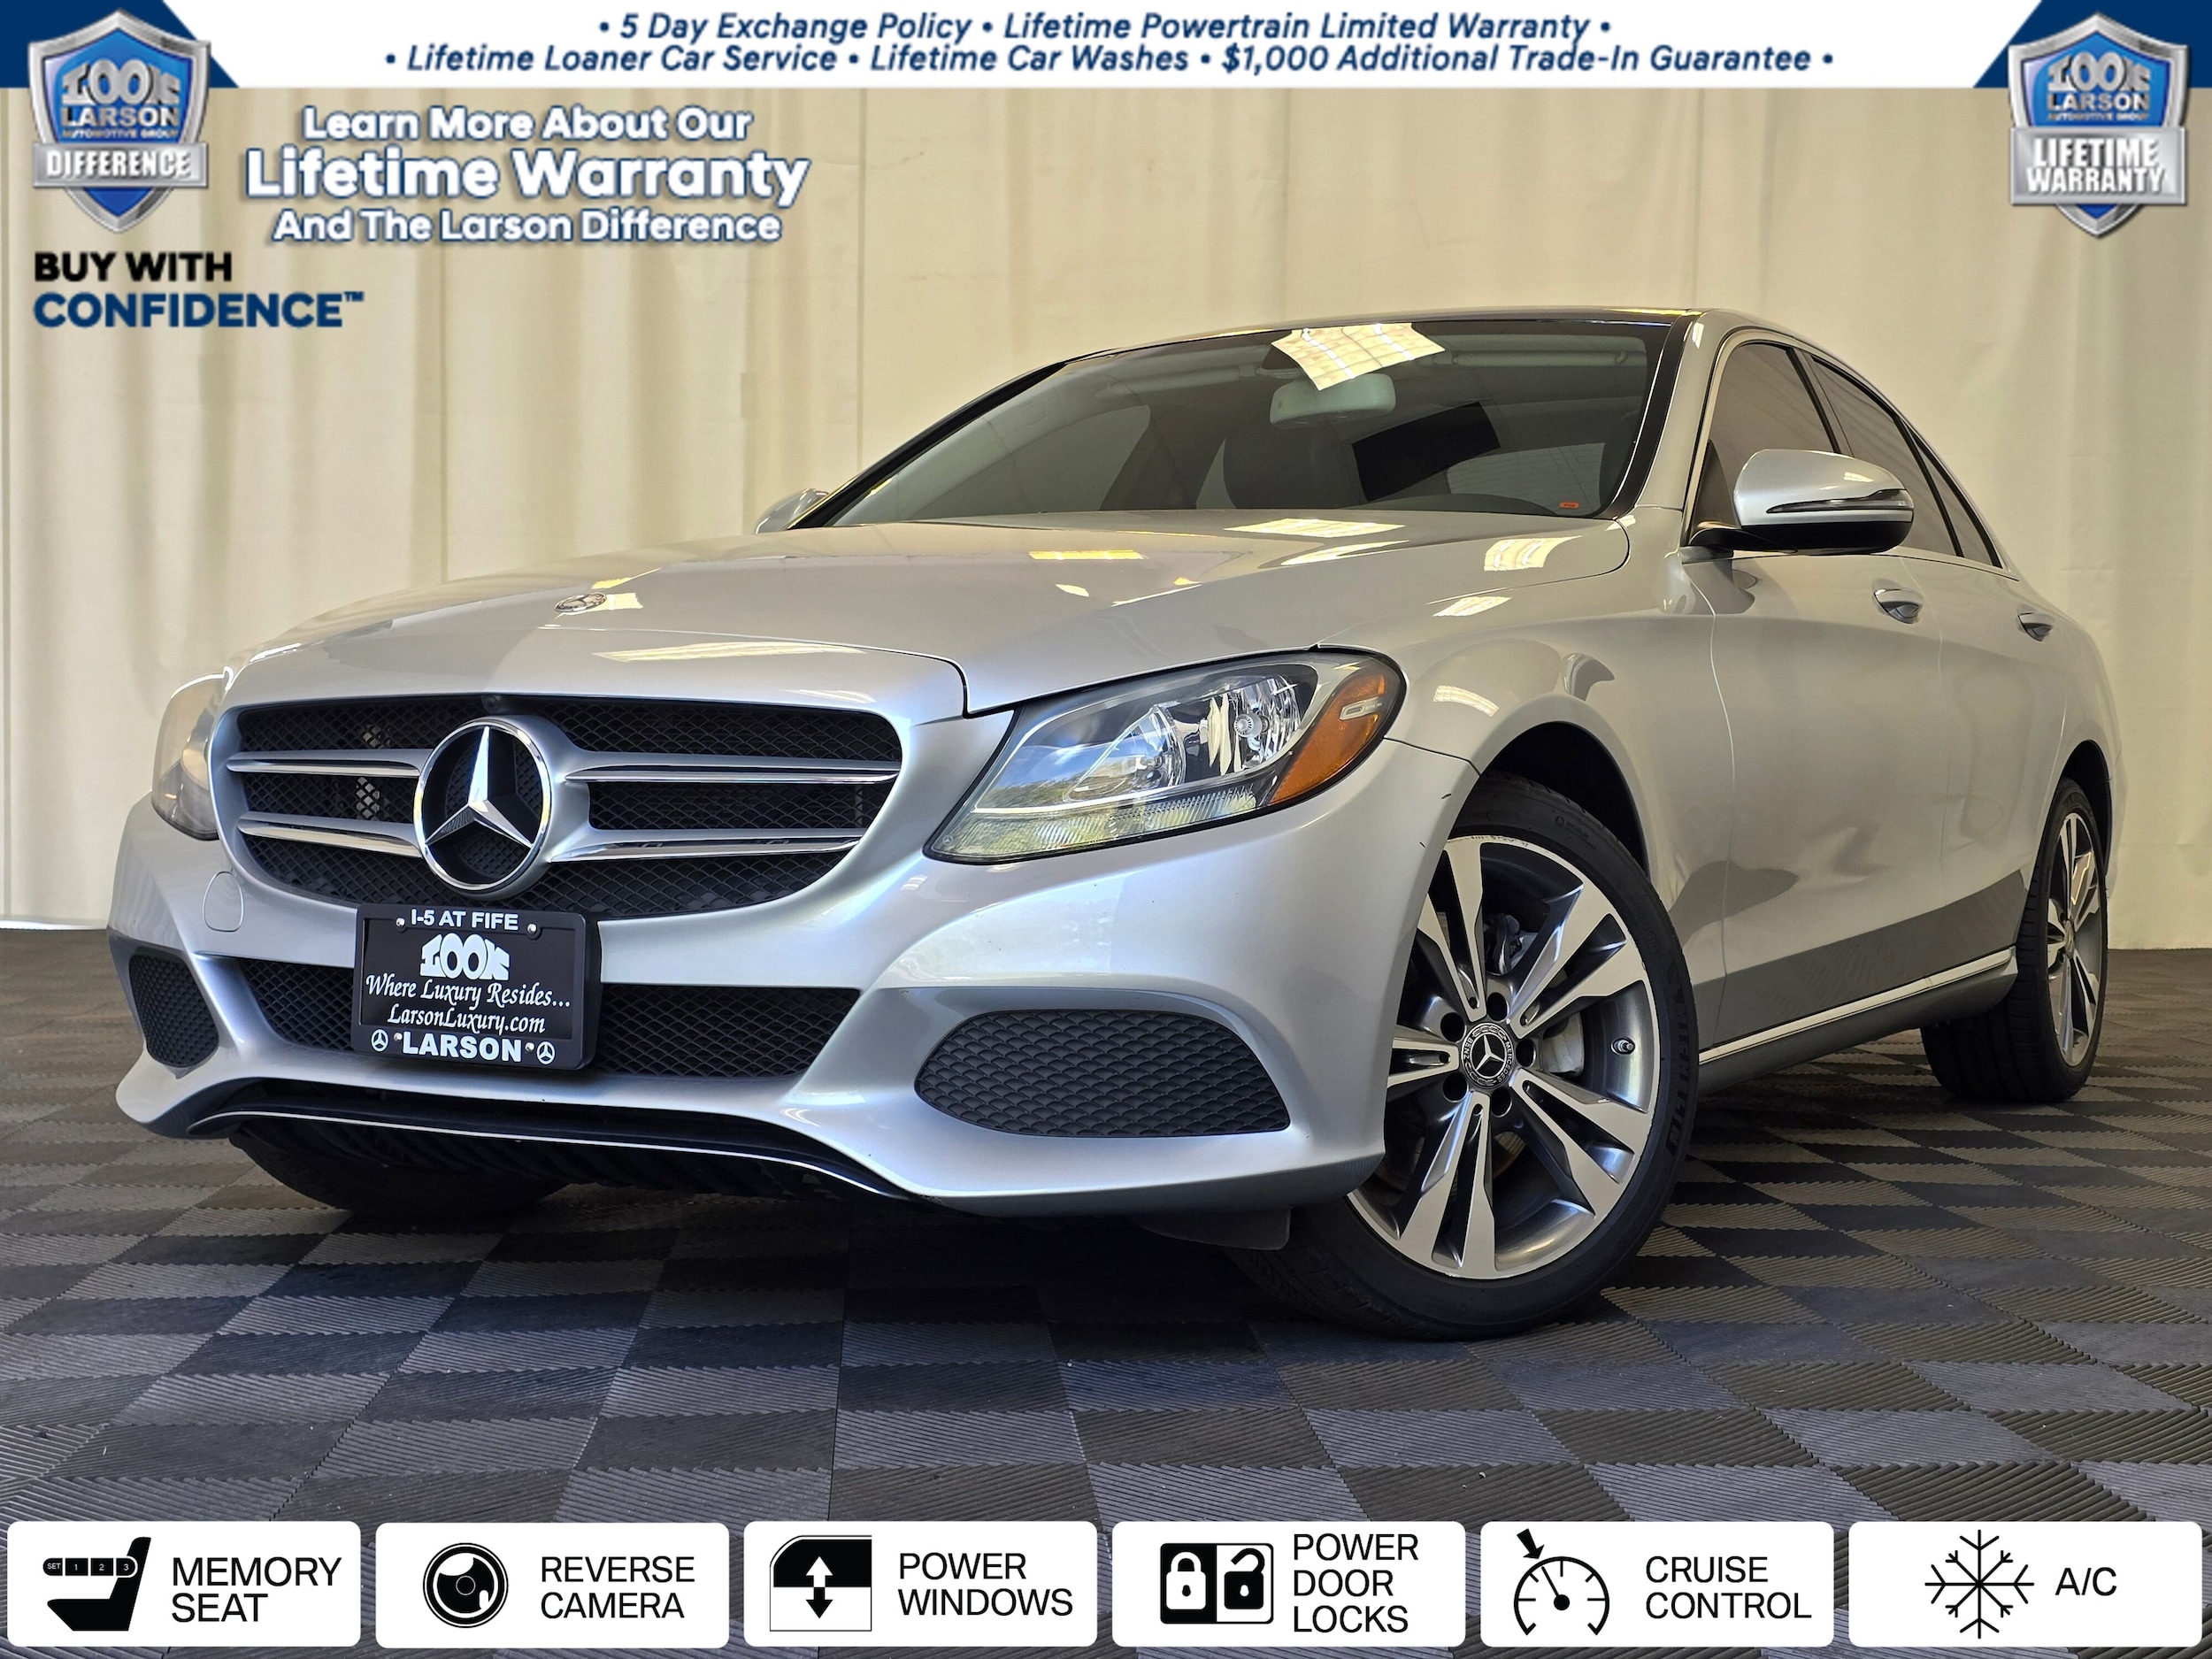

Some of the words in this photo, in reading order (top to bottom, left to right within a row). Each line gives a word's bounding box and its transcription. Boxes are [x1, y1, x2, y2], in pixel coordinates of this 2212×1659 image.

[411, 909, 435, 926] I-5
[439, 910, 466, 927] AT
[471, 911, 518, 930] FIFE
[365, 973, 417, 997] Where
[420, 979, 482, 1010] Luxury
[487, 982, 571, 1008] Resides...
[388, 1003, 546, 1035] LarsonLuxury.com
[403, 1031, 521, 1062] LARSON
[1463, 1037, 1473, 1060] BENZ
[1497, 1041, 1512, 1082] MERCEDES
